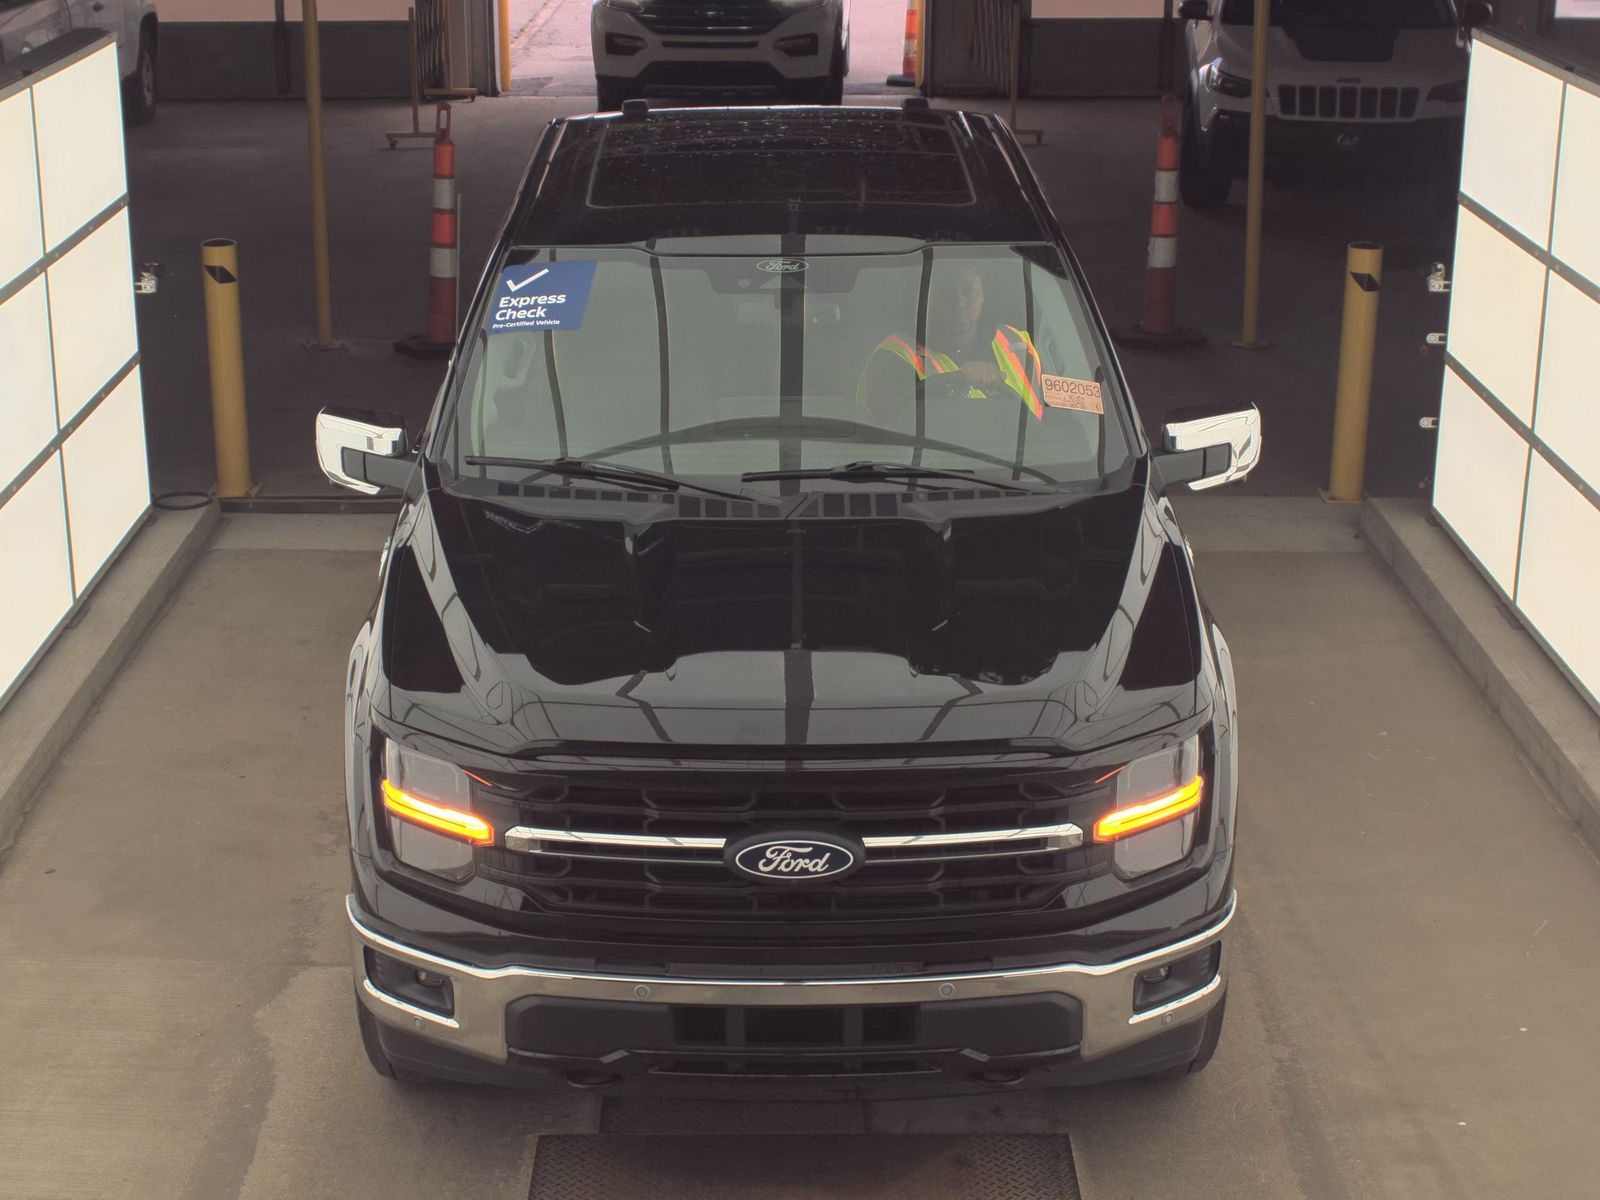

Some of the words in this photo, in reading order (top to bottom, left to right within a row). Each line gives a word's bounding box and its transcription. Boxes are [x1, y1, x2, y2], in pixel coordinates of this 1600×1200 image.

[499, 294, 567, 308] Express
[495, 306, 548, 321] Check
[492, 320, 535, 329] Pre-Certified
[1045, 378, 1100, 398] 9602053
[758, 845, 831, 872] Ford
